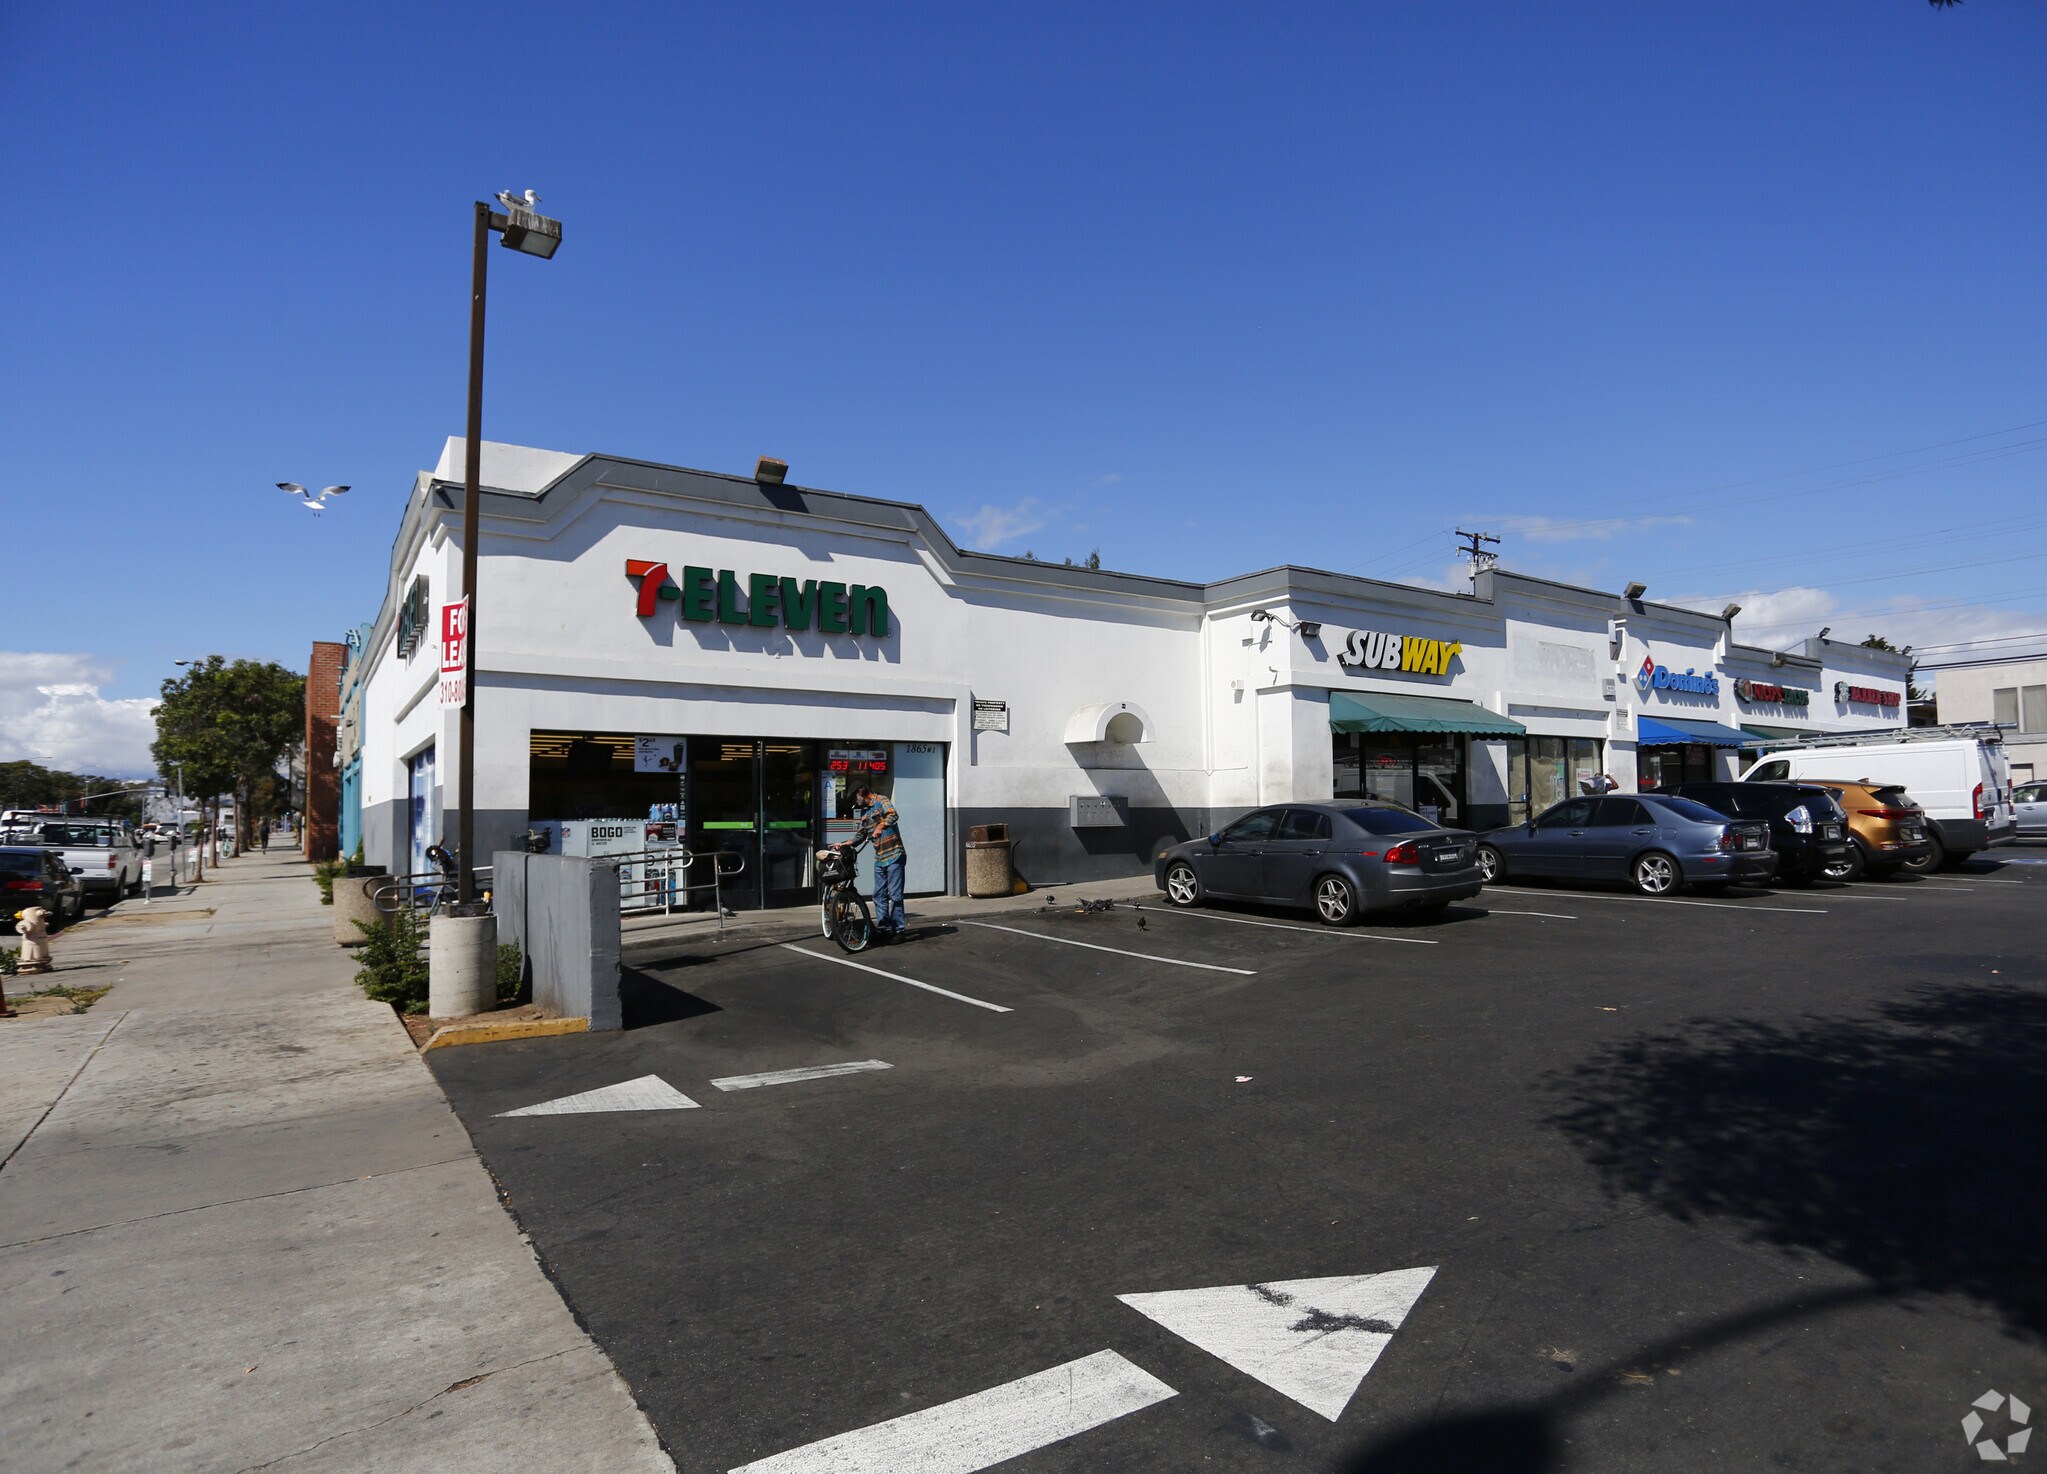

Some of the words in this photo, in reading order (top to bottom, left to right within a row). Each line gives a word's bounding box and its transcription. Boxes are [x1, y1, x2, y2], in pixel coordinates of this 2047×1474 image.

[1338, 629, 1463, 675] SUBWAY
[1653, 665, 1720, 695] Domino's
[1850, 686, 1881, 704] BARBER
[1882, 691, 1901, 706] SHOP
[830, 760, 848, 770] 253
[591, 826, 623, 838] BOGO
